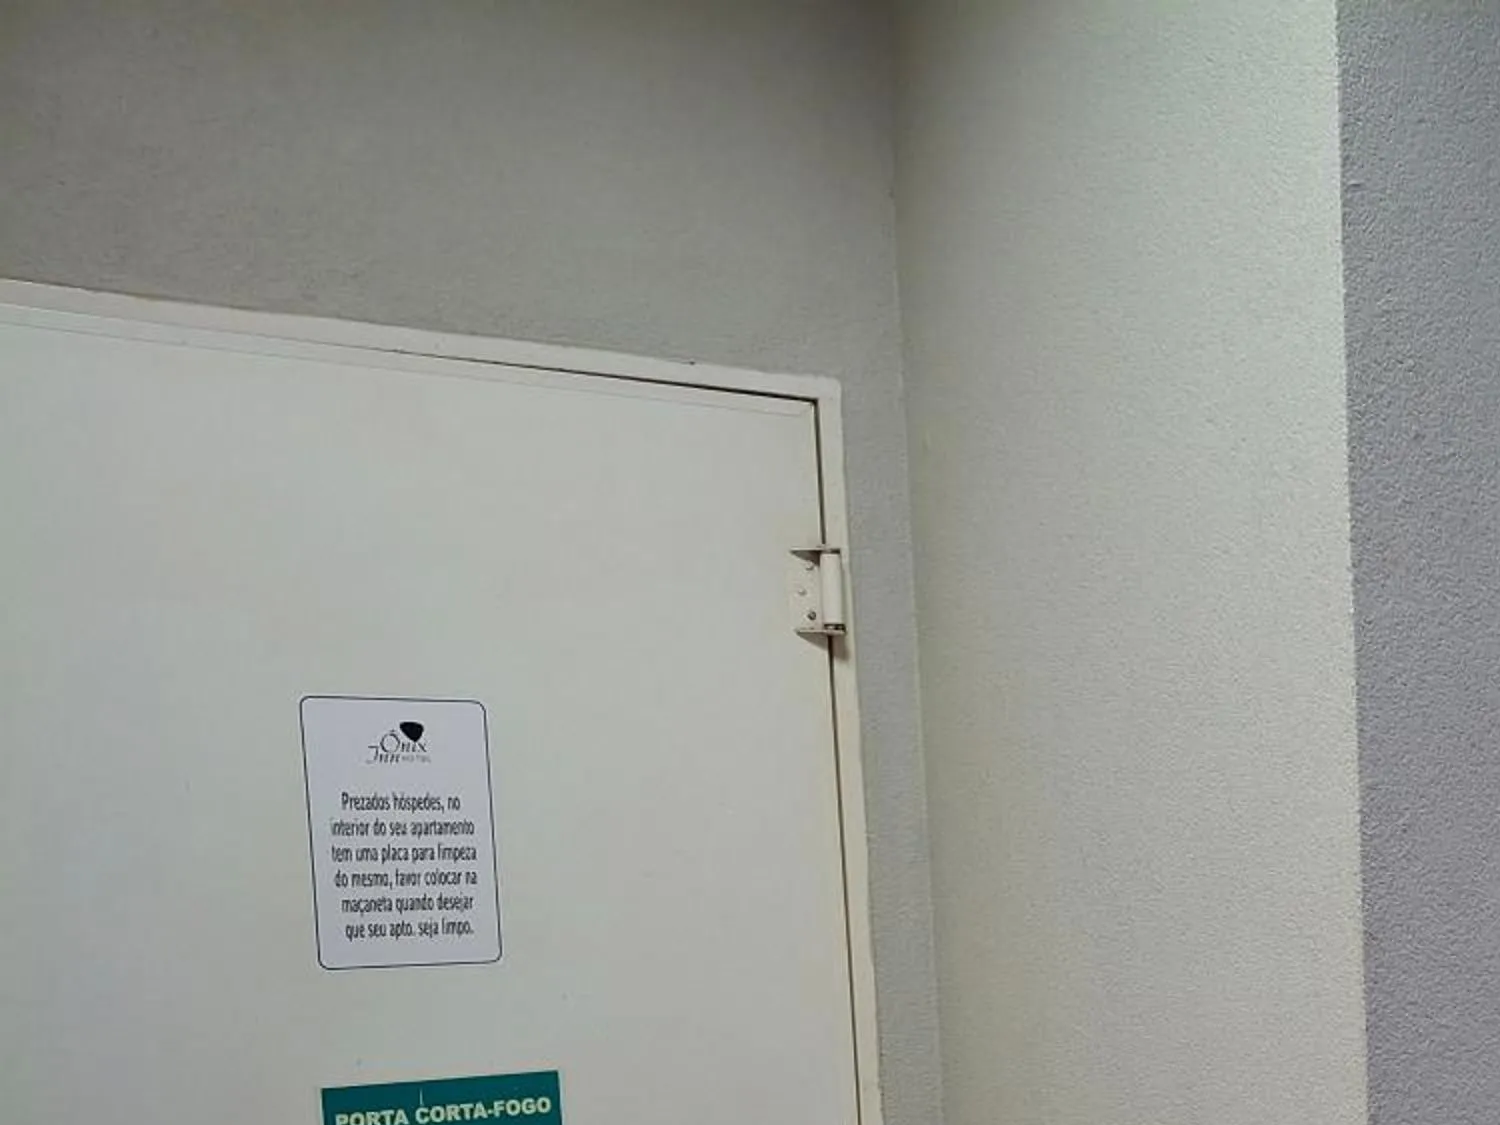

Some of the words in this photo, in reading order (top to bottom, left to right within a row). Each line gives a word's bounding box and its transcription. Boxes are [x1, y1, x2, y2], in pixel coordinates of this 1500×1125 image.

[341, 792, 390, 811] Prezados
[393, 792, 445, 814] hóspedes,
[448, 795, 461, 810] no
[331, 819, 370, 836] interior
[374, 818, 387, 836] do
[389, 823, 407, 835] seu
[410, 819, 475, 839] apartamento
[331, 845, 351, 862] tem
[356, 847, 378, 861] uma
[381, 843, 409, 864] placa
[412, 846, 435, 864] para
[437, 843, 477, 864] limpeza
[334, 869, 348, 888] do
[351, 871, 392, 890] mesmo,
[395, 868, 421, 886] favor
[424, 868, 462, 886] colocar
[465, 870, 477, 885] na
[341, 896, 393, 917] maçaneta
[396, 893, 434, 915] quando
[437, 893, 473, 911] desejar
[345, 922, 364, 942] que
[368, 921, 386, 937] seu
[389, 920, 416, 940] apto.
[418, 919, 439, 938] seja
[441, 917, 474, 937] limpo.
[415, 1097, 551, 1124] CORTA-FOGO
